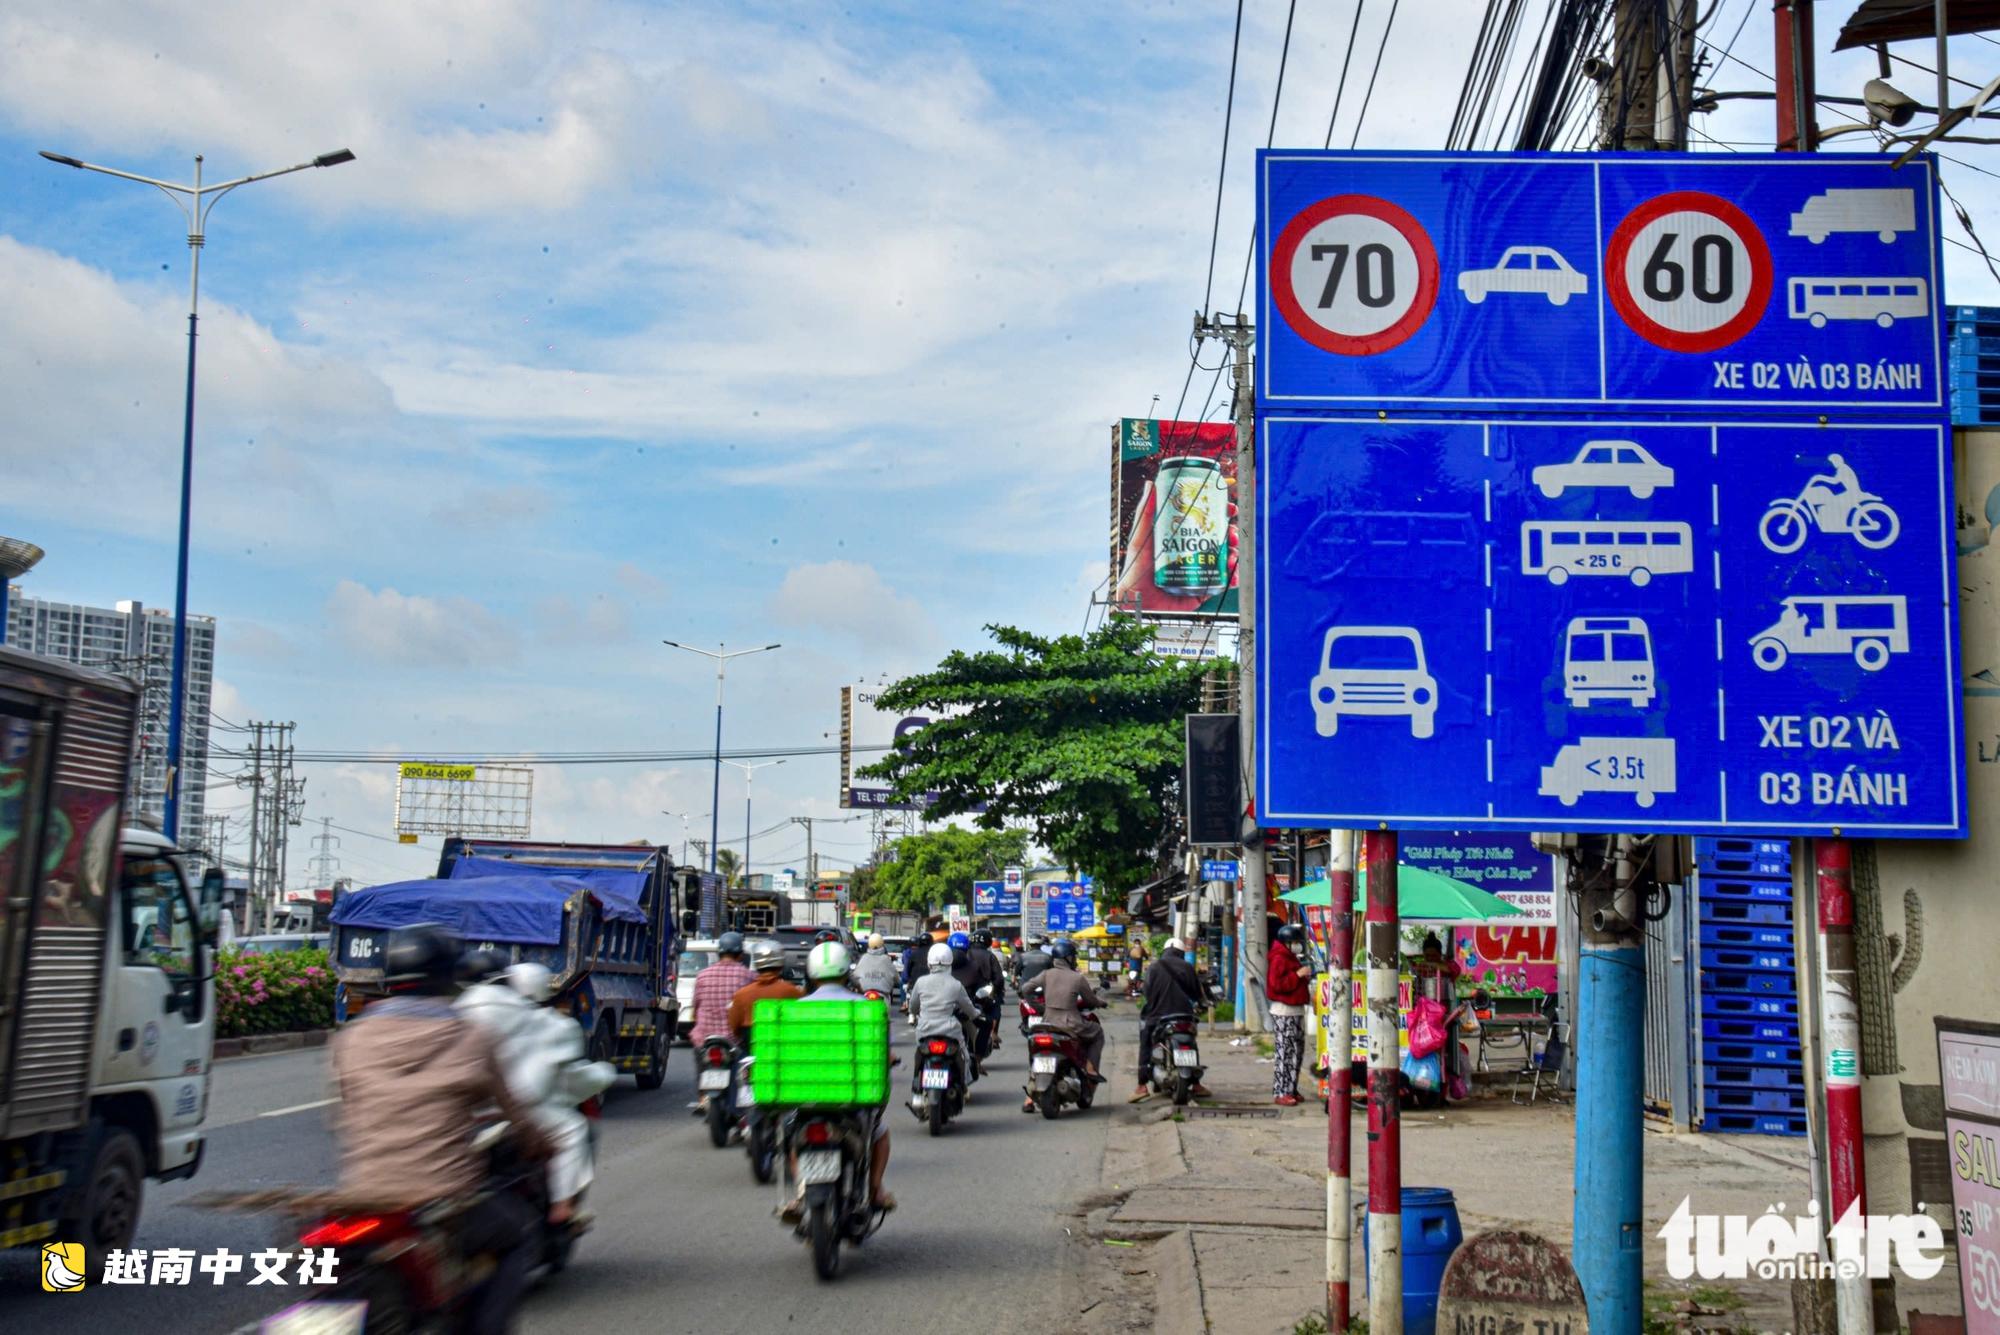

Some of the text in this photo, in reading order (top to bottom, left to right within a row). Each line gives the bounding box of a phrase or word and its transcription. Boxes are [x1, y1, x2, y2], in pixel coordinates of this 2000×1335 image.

[1311, 243, 1395, 308] 70
[1643, 233, 1734, 304] 60
[1713, 355, 1922, 390] XE 02 VÀ 03 BÁNH
[1180, 527, 1201, 537] BIA
[1162, 538, 1219, 553] SAIGON
[1167, 554, 1216, 565] LAGER
[1589, 555, 1608, 568] 25
[1612, 555, 1622, 568] C
[1758, 709, 1900, 749] XE 02 VÀ
[403, 767, 472, 779] 090 464 6699
[1608, 757, 1645, 780] 3.5t
[856, 792, 871, 802] TEL
[1759, 765, 1907, 806] 03 BÁNH
[1519, 895, 1534, 905] 438
[1536, 895, 1551, 905] 834
[1959, 1208, 1973, 1237] 35
[1973, 1199, 1993, 1233] UP
